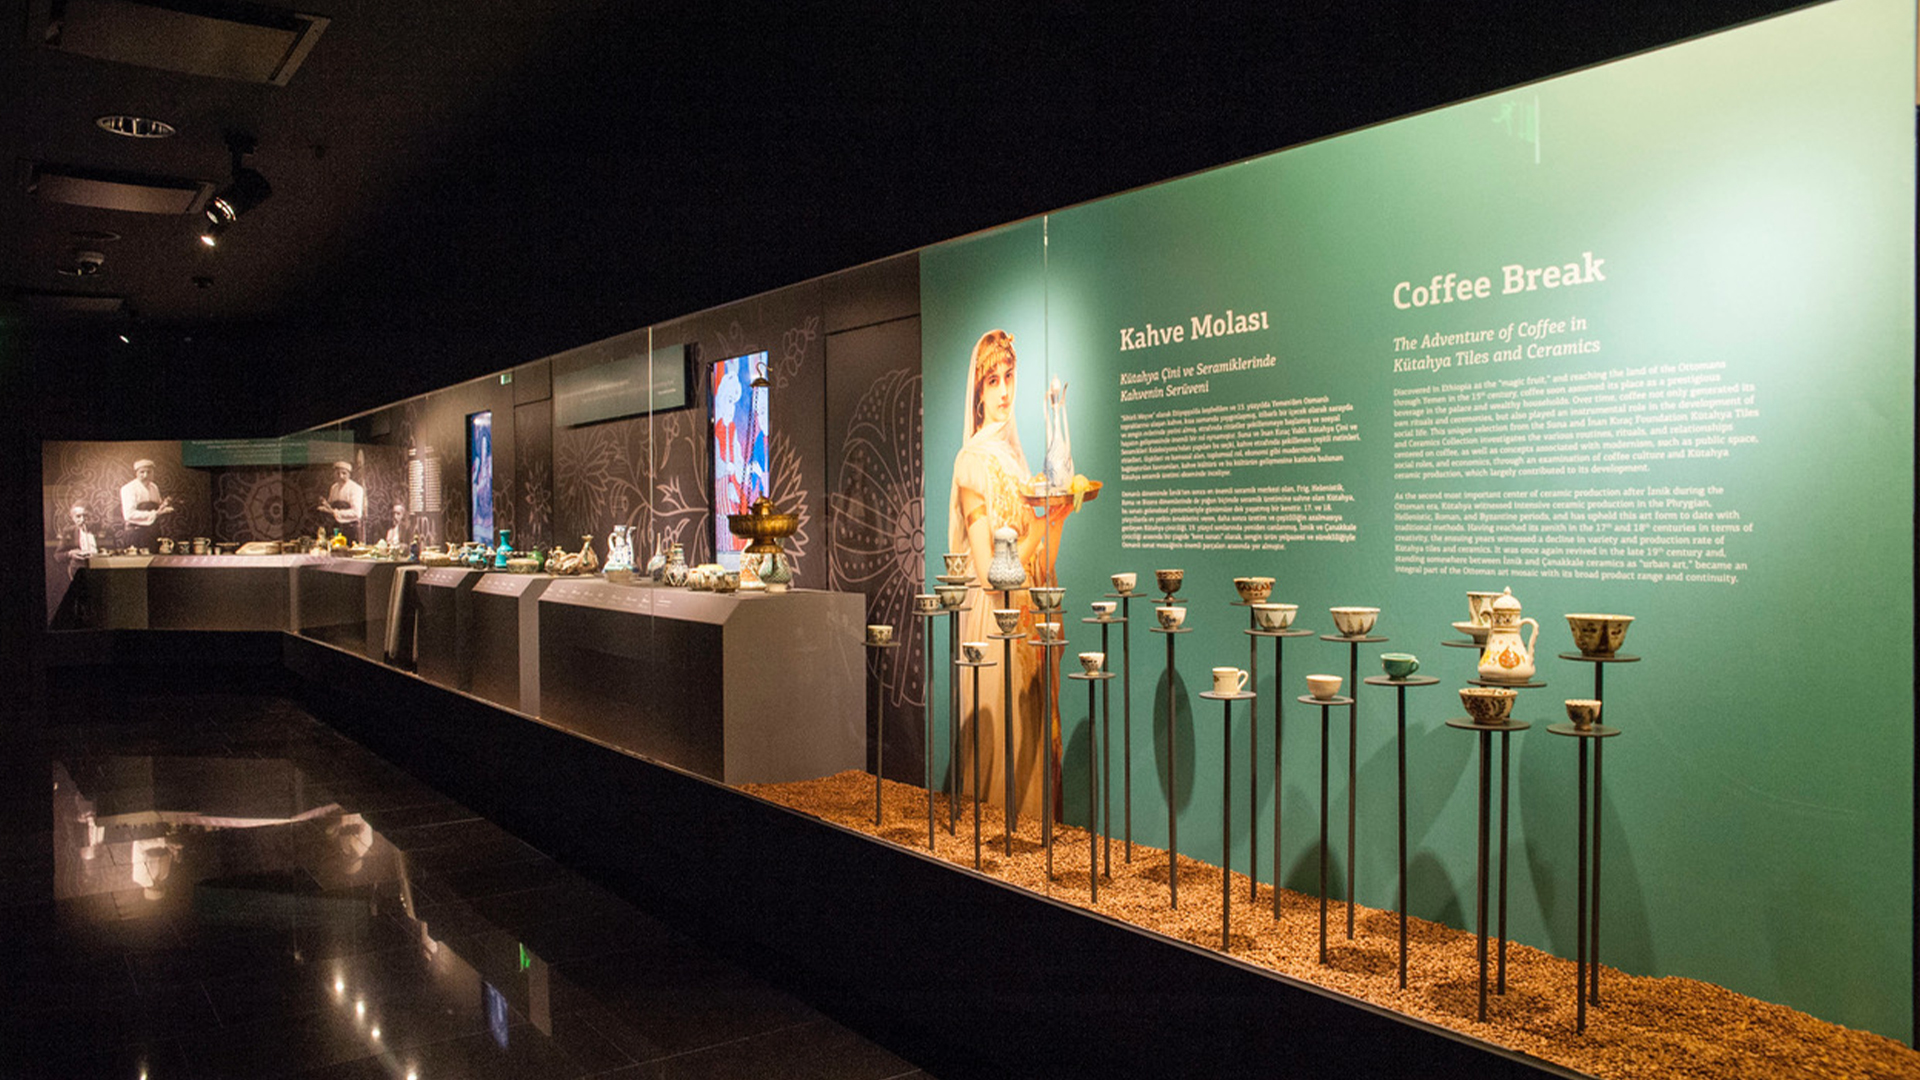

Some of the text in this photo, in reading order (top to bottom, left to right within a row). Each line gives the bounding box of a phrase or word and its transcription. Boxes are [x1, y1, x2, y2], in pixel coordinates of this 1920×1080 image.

[1393, 252, 1606, 309] Coffee Break
[1120, 310, 1269, 351] Kahve Molası
[1393, 317, 1587, 351] The Adventure of Coffee in
[1393, 339, 1601, 372] Kütahya Tiles and Ceramics
[1120, 354, 1276, 385] Kütahya Çini ve Seramiklerinde
[1553, 360, 1726, 383] and reaching the land of the Ottomans
[1120, 381, 1209, 402] Kahvenin Serüveni
[1568, 382, 1606, 393] assumed
[1607, 381, 1619, 390] its
[1621, 379, 1644, 391] place
[1646, 379, 1657, 387] as
[1667, 373, 1721, 387] prestigious
[1572, 383, 1756, 404] Over coffee not only generated its
[1570, 404, 1627, 416] instrumental
[1628, 403, 1646, 412] role
[1649, 402, 1658, 411] in
[1660, 401, 1676, 410] the
[1678, 397, 1742, 411] development
[1744, 396, 1755, 404] of
[1547, 408, 1760, 429] Suna and Foundation Tiles
[1543, 423, 1734, 440] various and relationships
[1536, 436, 1725, 452] associated with such as public
[1538, 454, 1591, 463] examination
[1603, 452, 1630, 461] coffee
[1632, 451, 1665, 460] culture
[1668, 450, 1686, 458] and
[1567, 466, 1576, 474] to
[1540, 489, 1572, 497] ceramic
[1574, 488, 1621, 499] production
[1623, 487, 1645, 496] after
[1673, 486, 1706, 497] during
[1707, 485, 1724, 494] the
[1552, 500, 1585, 508] ceramic
[1587, 500, 1635, 510] production
[1637, 499, 1647, 508] in
[1649, 499, 1664, 508] the
[1553, 512, 1569, 520] and
[1570, 512, 1586, 520] has
[1588, 512, 1618, 522] upheld
[1619, 511, 1637, 520] this
[1639, 511, 1653, 519] art
[1654, 511, 1678, 519] form
[1680, 511, 1690, 519] to
[1692, 511, 1714, 519] date
[1717, 511, 1740, 519] with
[1541, 523, 1567, 531] zenith
[1568, 523, 1578, 531] in
[1579, 523, 1594, 531] the
[1614, 523, 1632, 532] and
[1653, 523, 1696, 532] centuries
[1699, 523, 1709, 532] in
[1711, 523, 1741, 532] terms
[1743, 523, 1753, 532] of
[1545, 535, 1575, 543] decline
[1577, 535, 1586, 543] in
[1588, 535, 1618, 546] variety
[1621, 535, 1638, 544] and
[1639, 535, 1691, 546] production
[1692, 536, 1712, 544] rate
[1715, 536, 1725, 544] of
[1541, 546, 1703, 559] again revived in the late century
[1586, 558, 1625, 567] ceramics
[1695, 561, 1732, 570] became
[1541, 569, 1560, 577] with
[1562, 569, 1573, 578] its
[1574, 570, 1600, 578] broad
[1601, 571, 1635, 582] product
[1637, 573, 1664, 583] range
[1666, 572, 1684, 581] and
